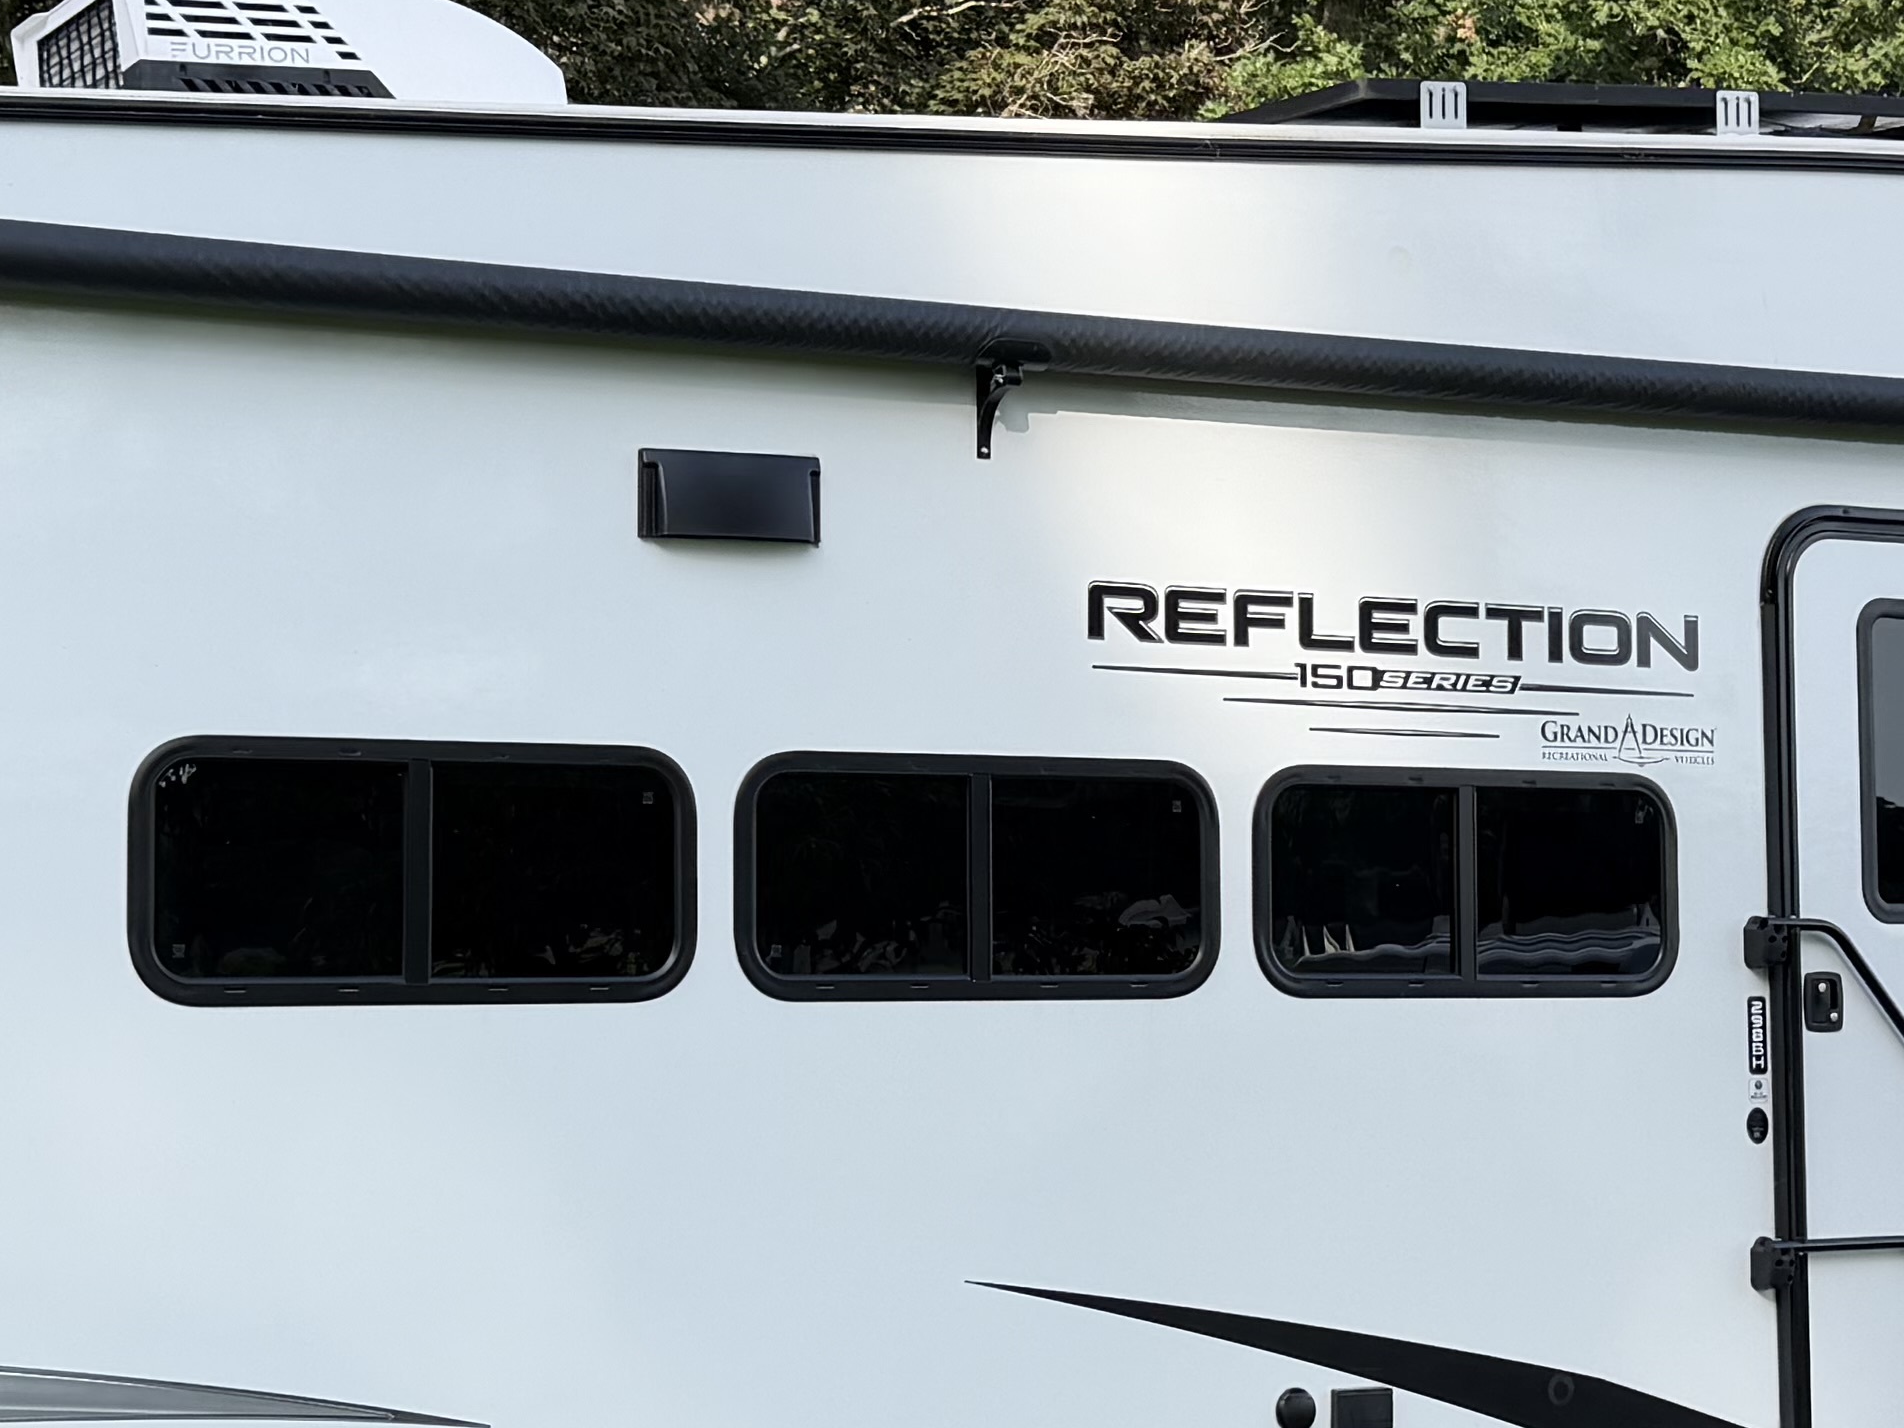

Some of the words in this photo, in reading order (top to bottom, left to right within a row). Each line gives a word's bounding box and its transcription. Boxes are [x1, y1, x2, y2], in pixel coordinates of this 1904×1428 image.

[169, 41, 310, 64] FURRION
[1086, 580, 1699, 672] REFLECTION
[1294, 663, 1378, 691] 150
[1379, 671, 1517, 692] SERIES
[1540, 720, 1619, 744] GRAND
[1641, 723, 1715, 748] DESIGN
